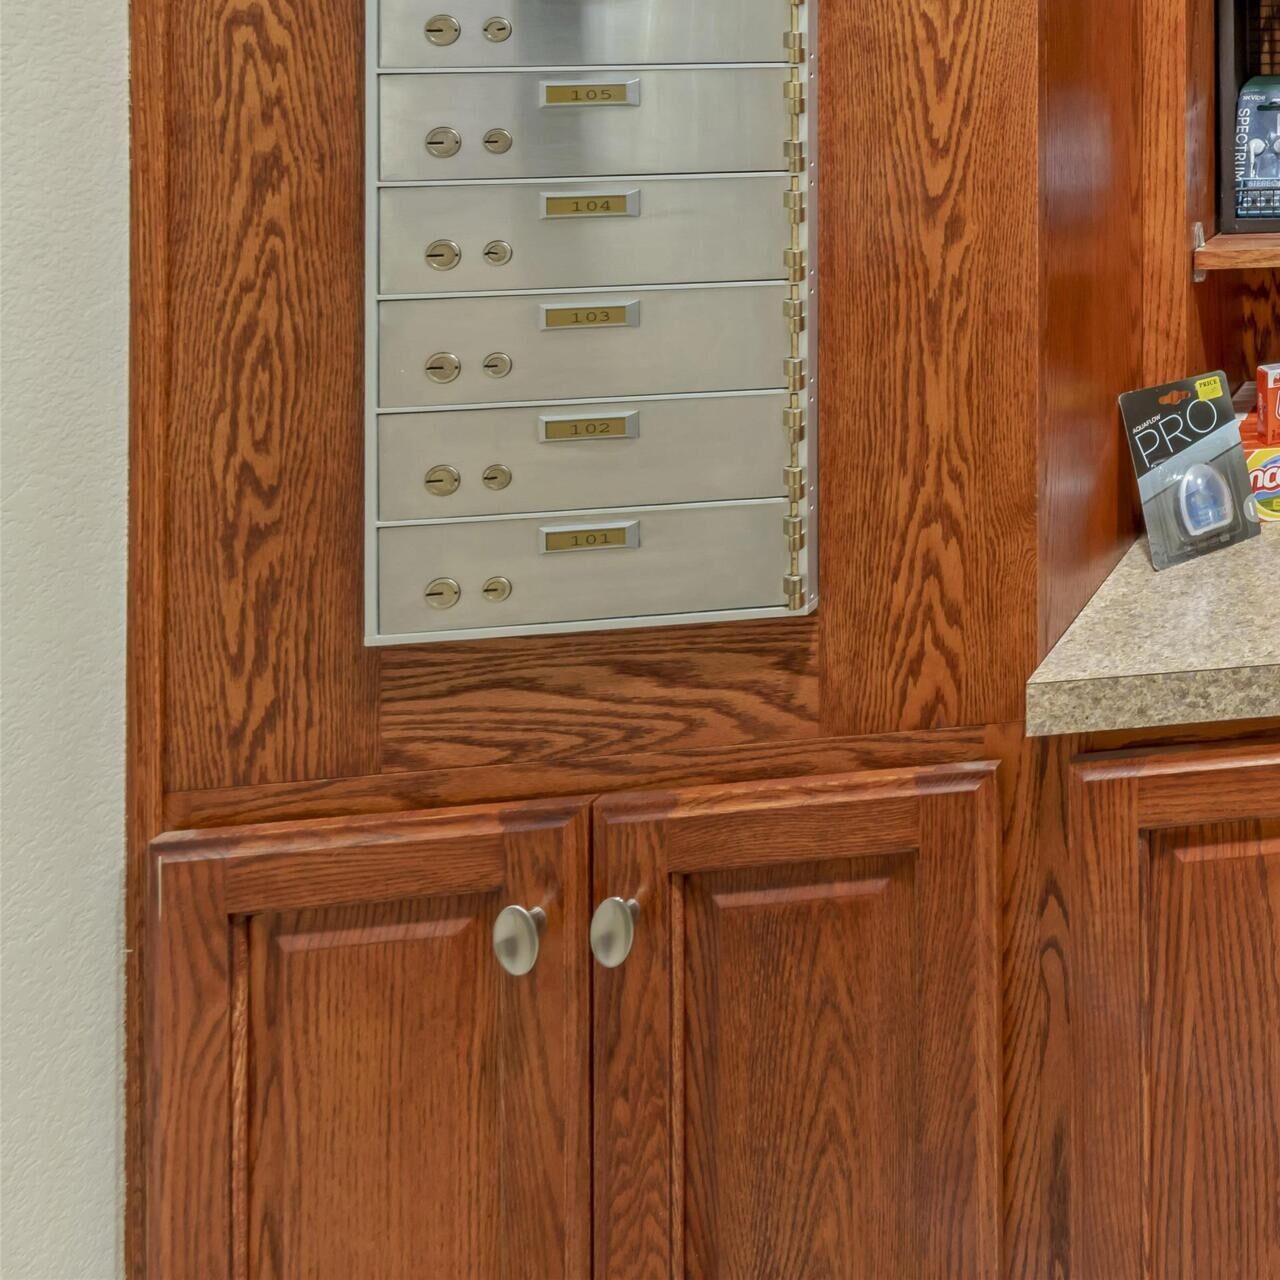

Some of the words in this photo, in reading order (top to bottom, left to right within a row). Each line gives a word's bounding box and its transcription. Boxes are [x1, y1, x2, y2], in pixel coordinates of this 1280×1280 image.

[570, 89, 612, 101] 105
[571, 200, 611, 212] 104
[571, 311, 610, 323] 103
[1199, 379, 1217, 388] PRICE
[570, 423, 610, 435] 102
[1132, 414, 1160, 434] AQUAFLOW
[1135, 399, 1217, 468] PRO
[571, 533, 610, 546] 101
